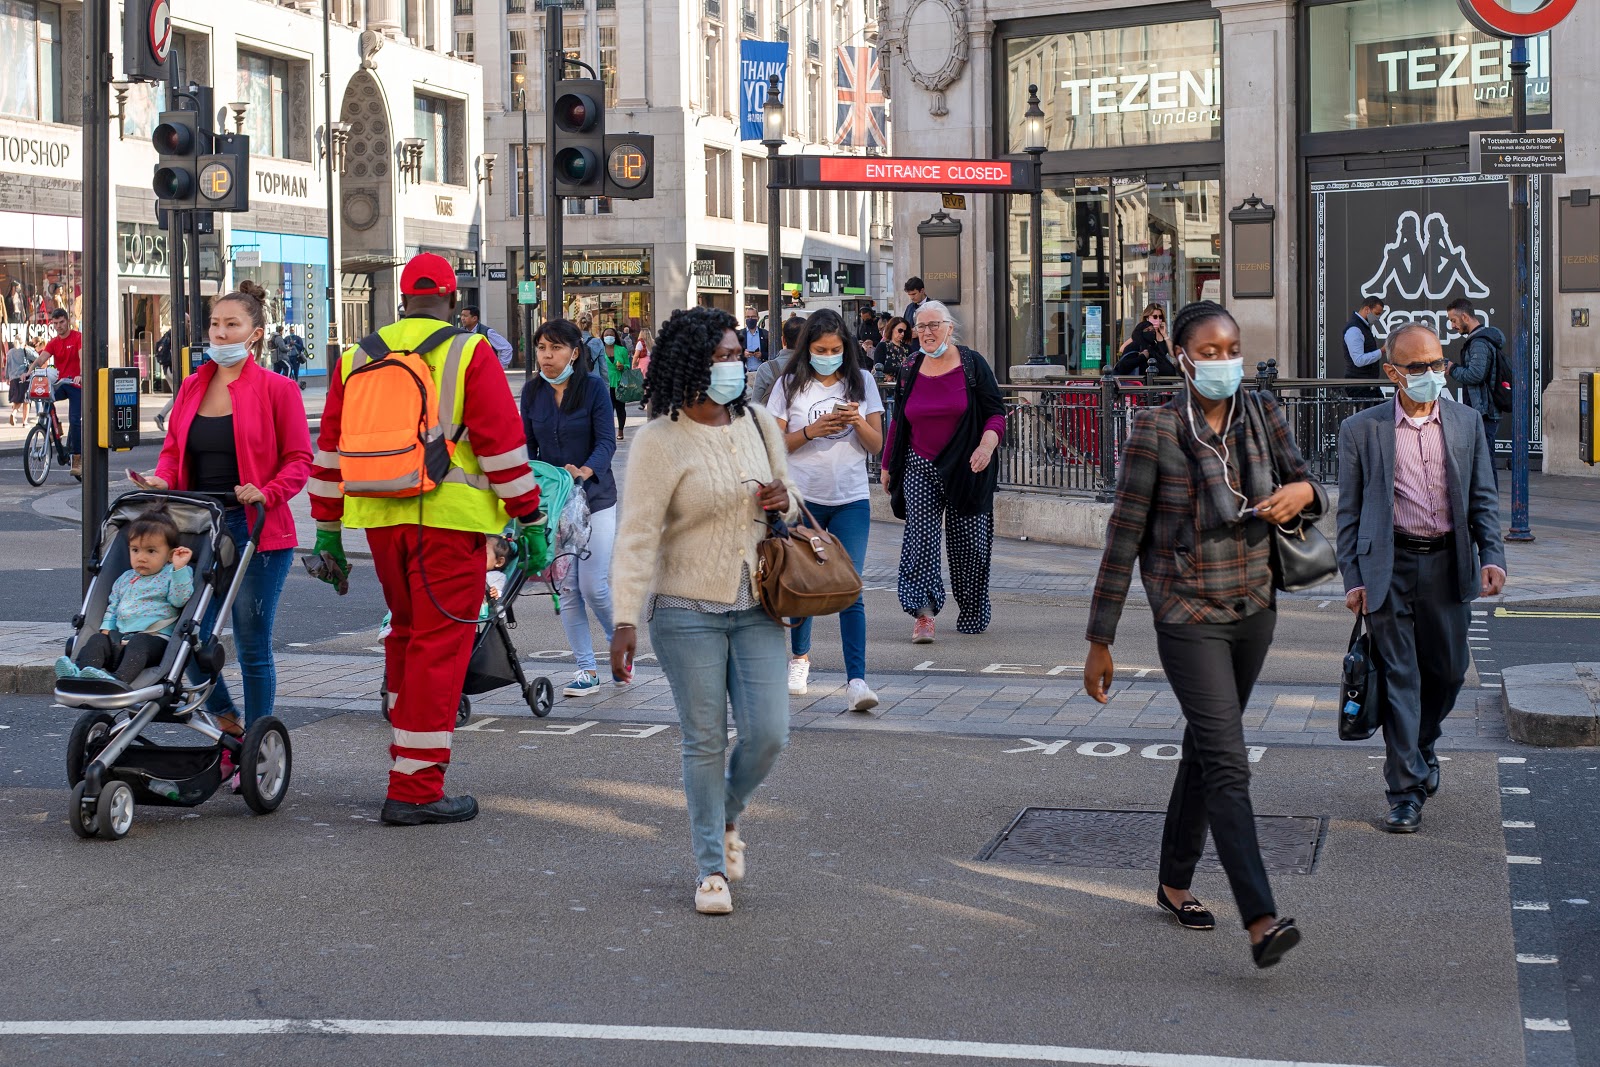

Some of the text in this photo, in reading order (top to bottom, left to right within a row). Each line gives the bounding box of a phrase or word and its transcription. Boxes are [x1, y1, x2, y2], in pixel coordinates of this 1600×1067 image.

[742, 60, 785, 81] THANK
[744, 80, 783, 113] YO
[1474, 82, 1549, 100] undrw
[0, 136, 70, 168] TOPSHOP
[624, 154, 642, 178] 12
[866, 164, 941, 179] ENTRANCE
[212, 170, 227, 193] 12
[255, 170, 308, 198] TOPMAN
[434, 194, 453, 217] VANS
[944, 197, 964, 207] RVP
[572, 260, 642, 275] OUTFITTERS
[1235, 262, 1271, 271] TEZENIS
[1563, 254, 1599, 264] TEZENIS
[925, 271, 958, 280] TEZENIS
[1, 322, 58, 342] NEW seas
[114, 394, 134, 405] WAIT
